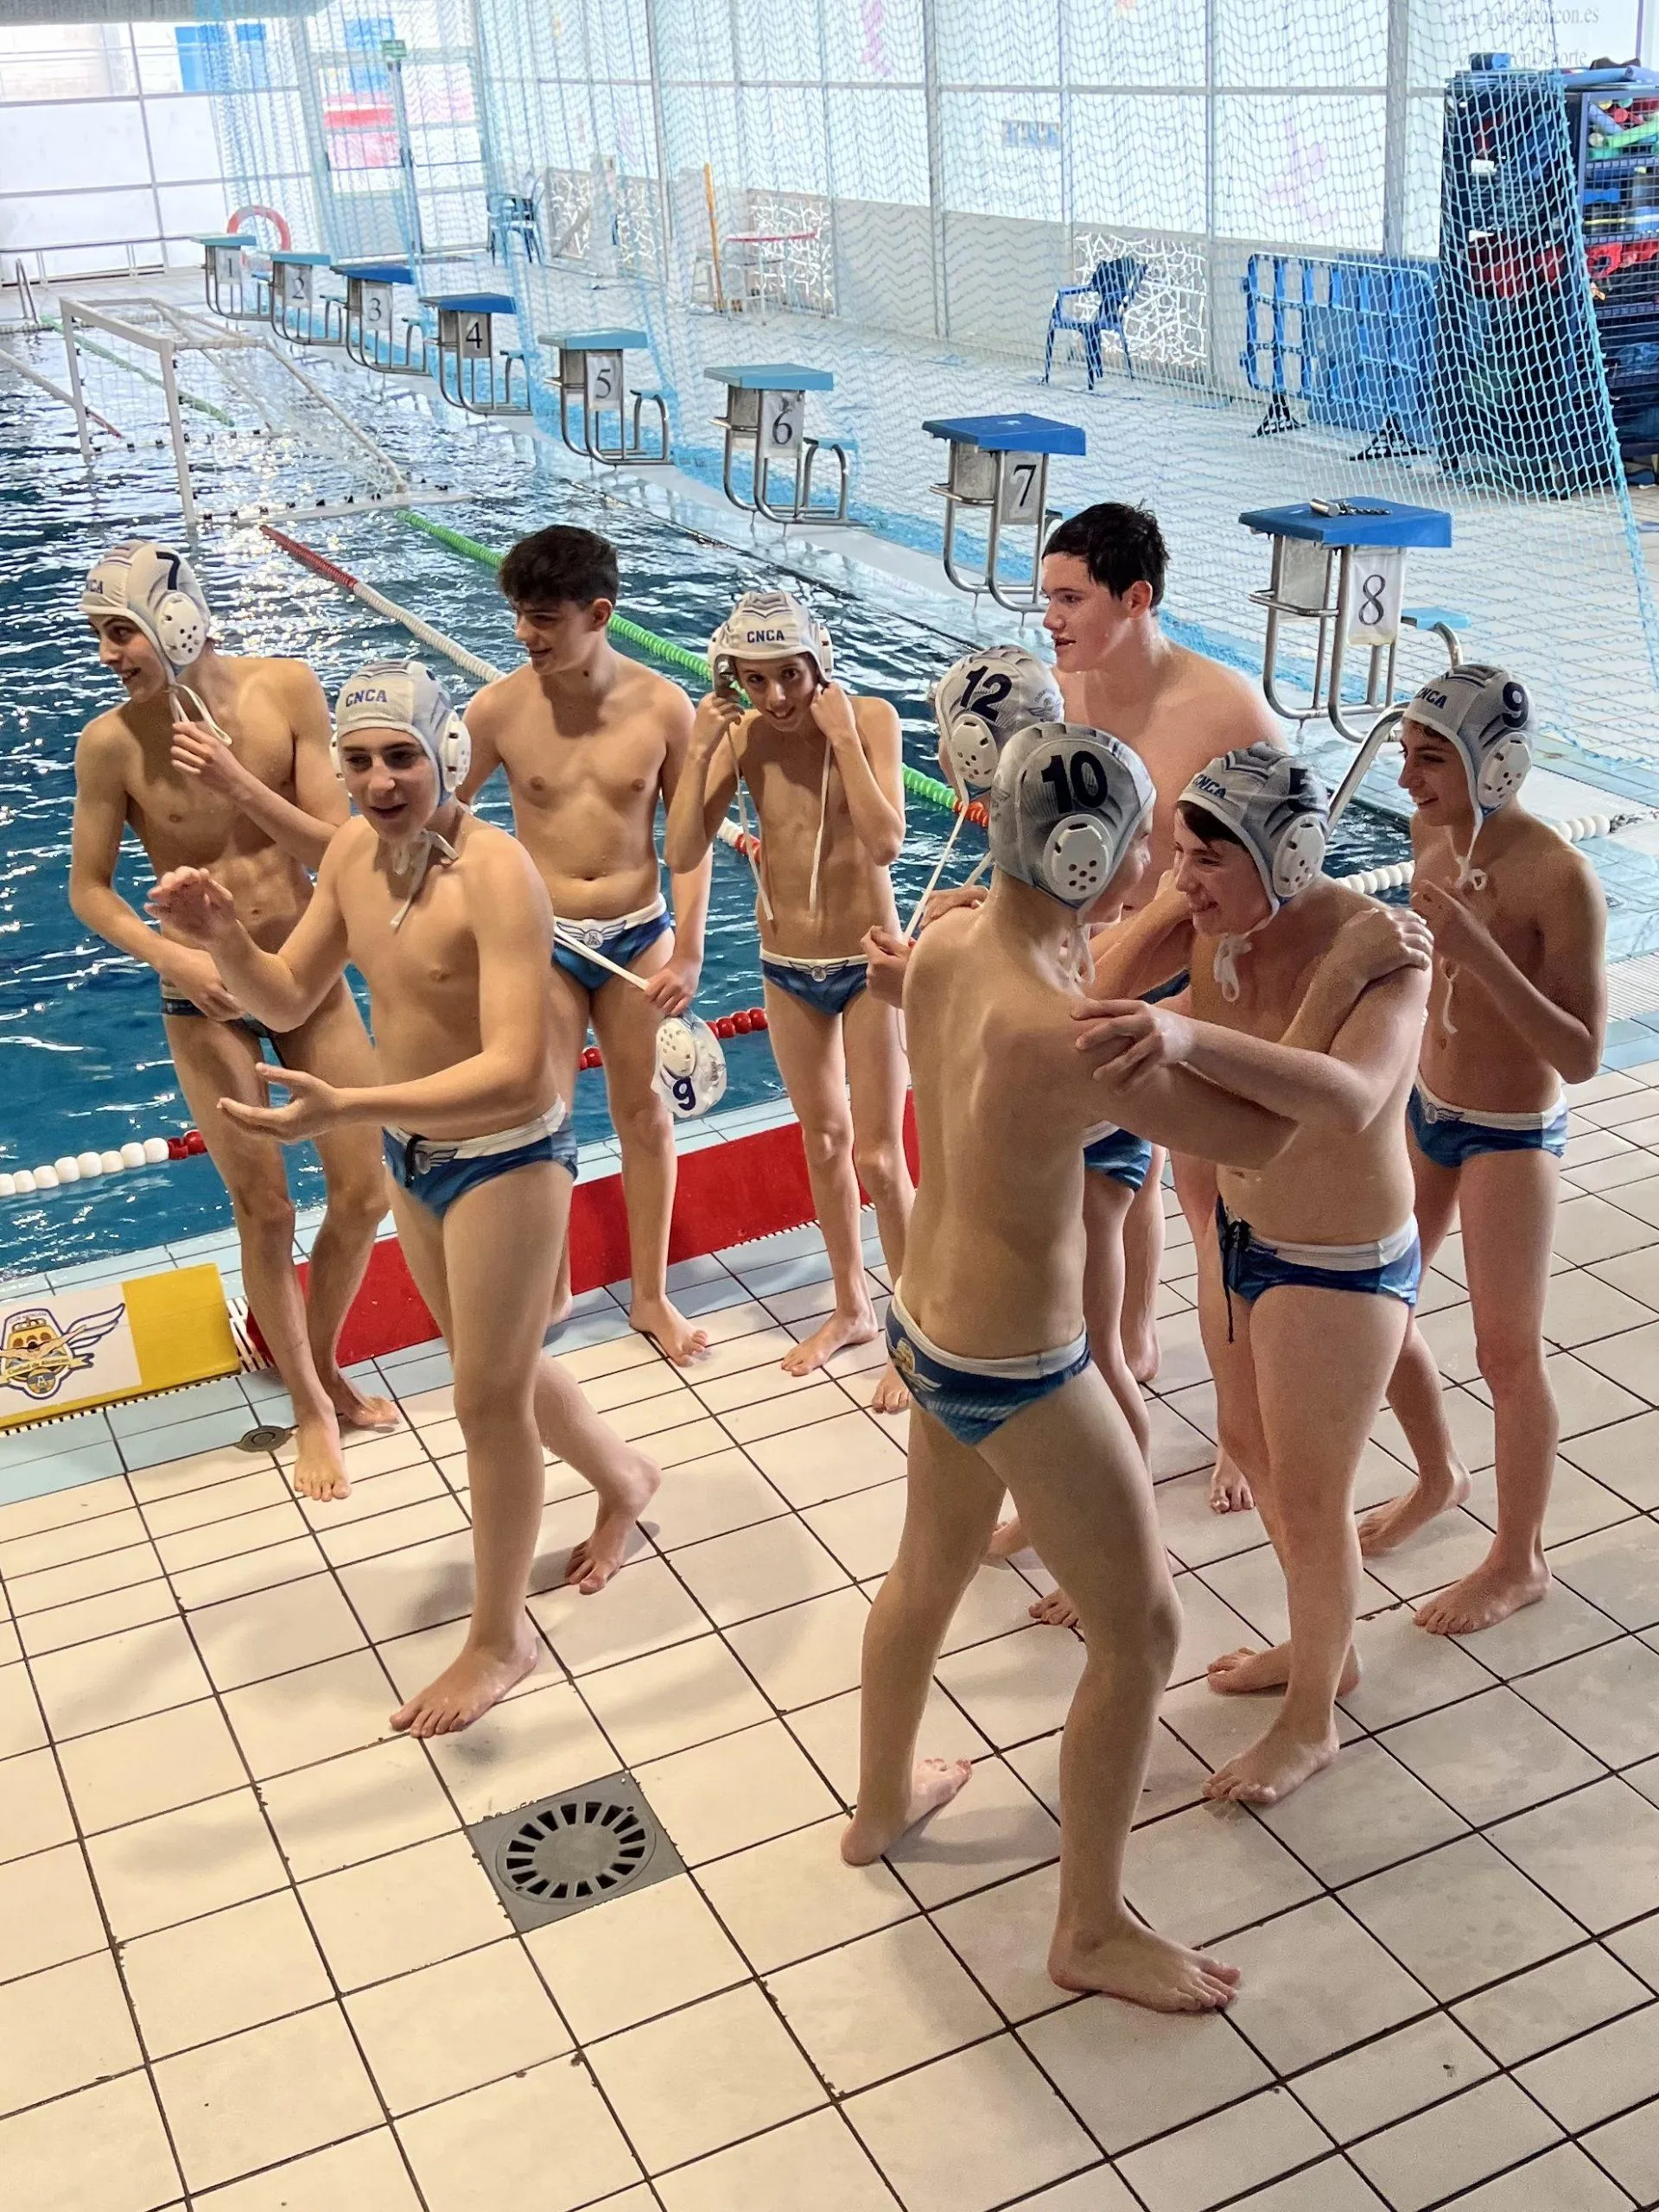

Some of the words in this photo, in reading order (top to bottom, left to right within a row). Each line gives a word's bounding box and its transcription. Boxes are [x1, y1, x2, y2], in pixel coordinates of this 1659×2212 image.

[227, 257, 232, 277] 1
[292, 276, 305, 300] 2
[368, 297, 381, 321] 3
[466, 321, 483, 349] 4
[595, 368, 611, 398] 5
[772, 410, 793, 444] 6
[1013, 464, 1037, 507] 7
[156, 551, 181, 590] 7
[1358, 574, 1386, 626] 8
[747, 629, 785, 643] CNCA
[346, 689, 388, 707] CNCA
[960, 664, 1013, 721] 12
[1502, 681, 1529, 728] 9
[1040, 750, 1109, 814] 10
